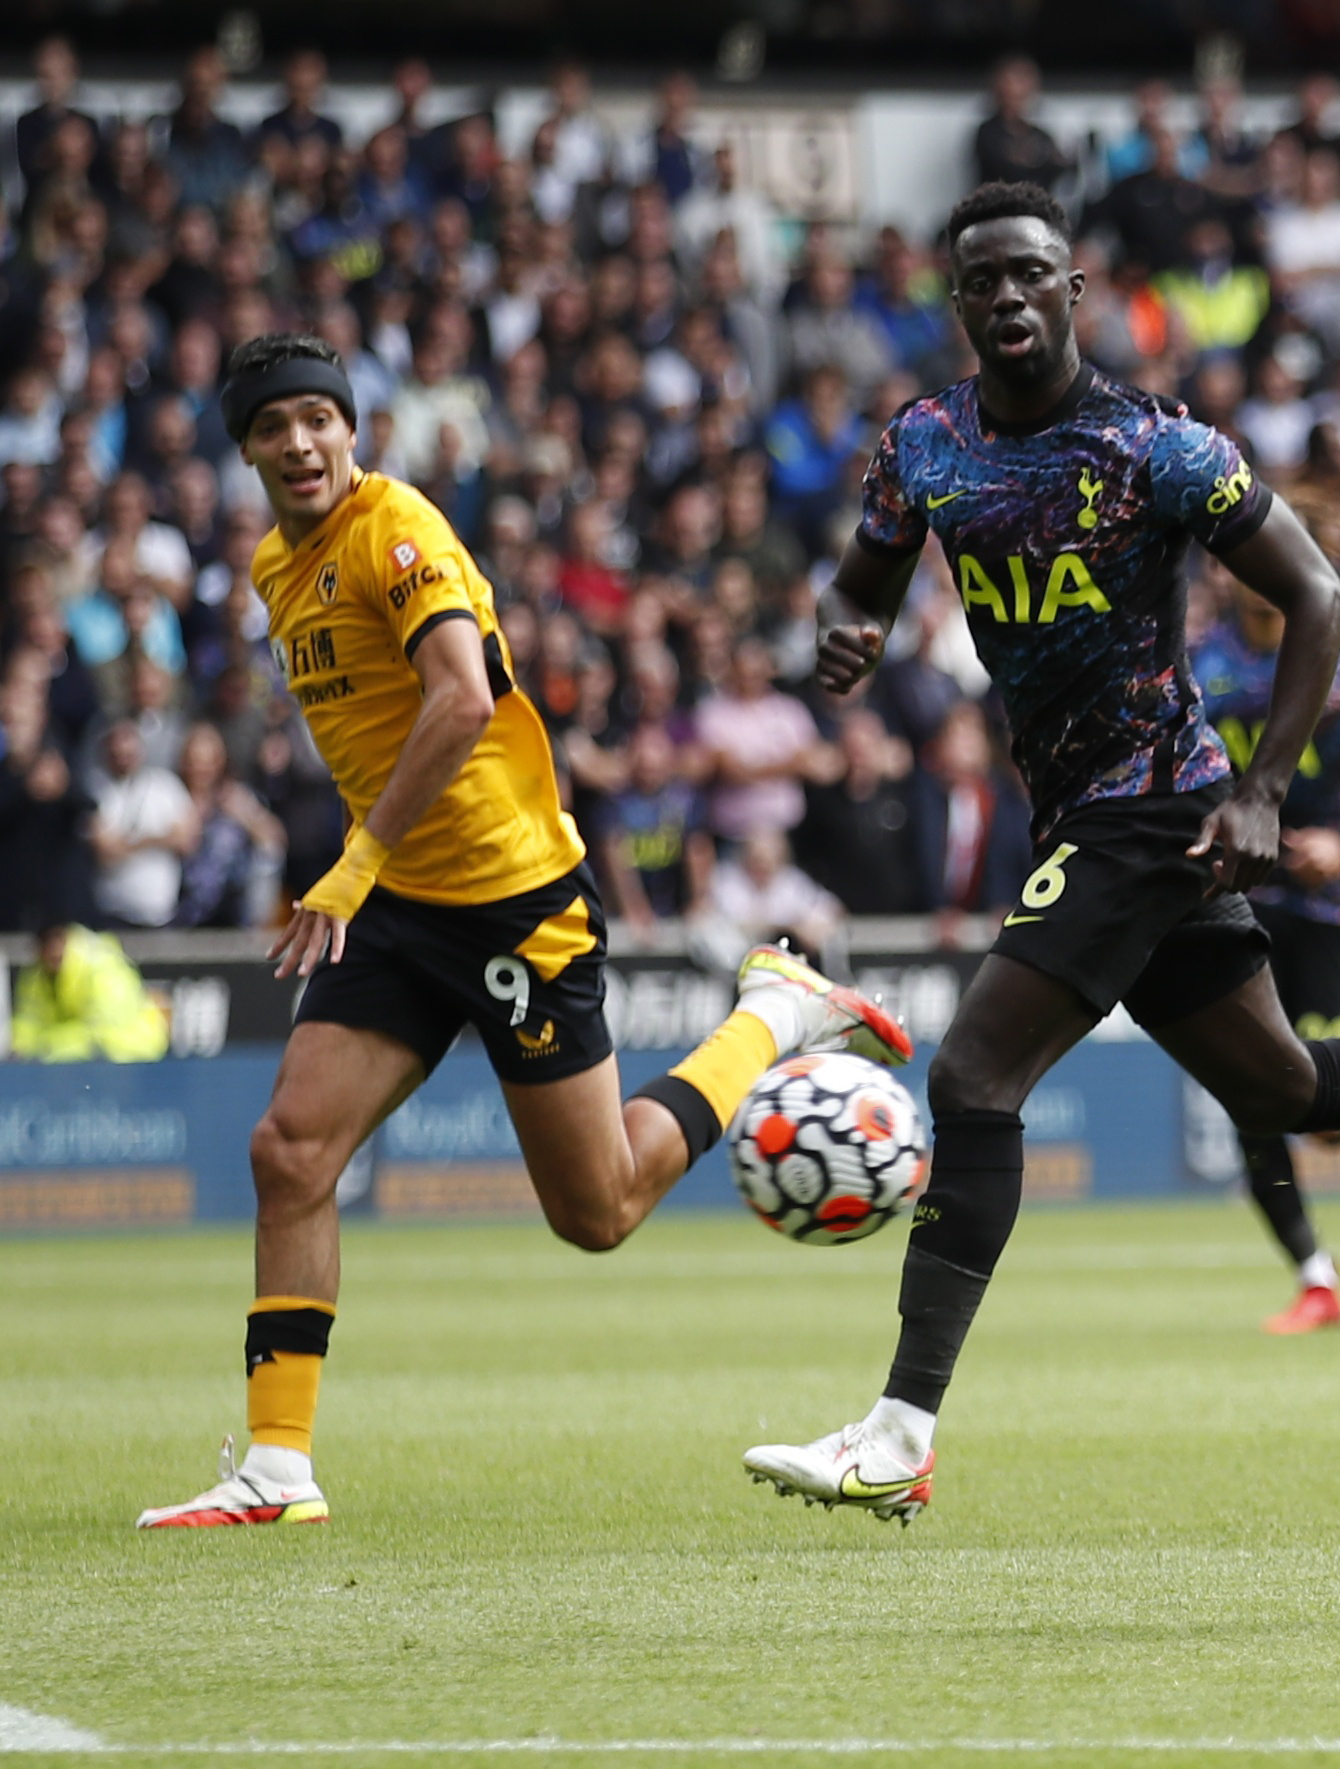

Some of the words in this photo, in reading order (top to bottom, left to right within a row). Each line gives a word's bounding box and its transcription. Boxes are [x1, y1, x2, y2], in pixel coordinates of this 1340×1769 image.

[958, 552, 1113, 623] AIA
[1021, 841, 1079, 909] 6
[484, 955, 530, 1027] 9
